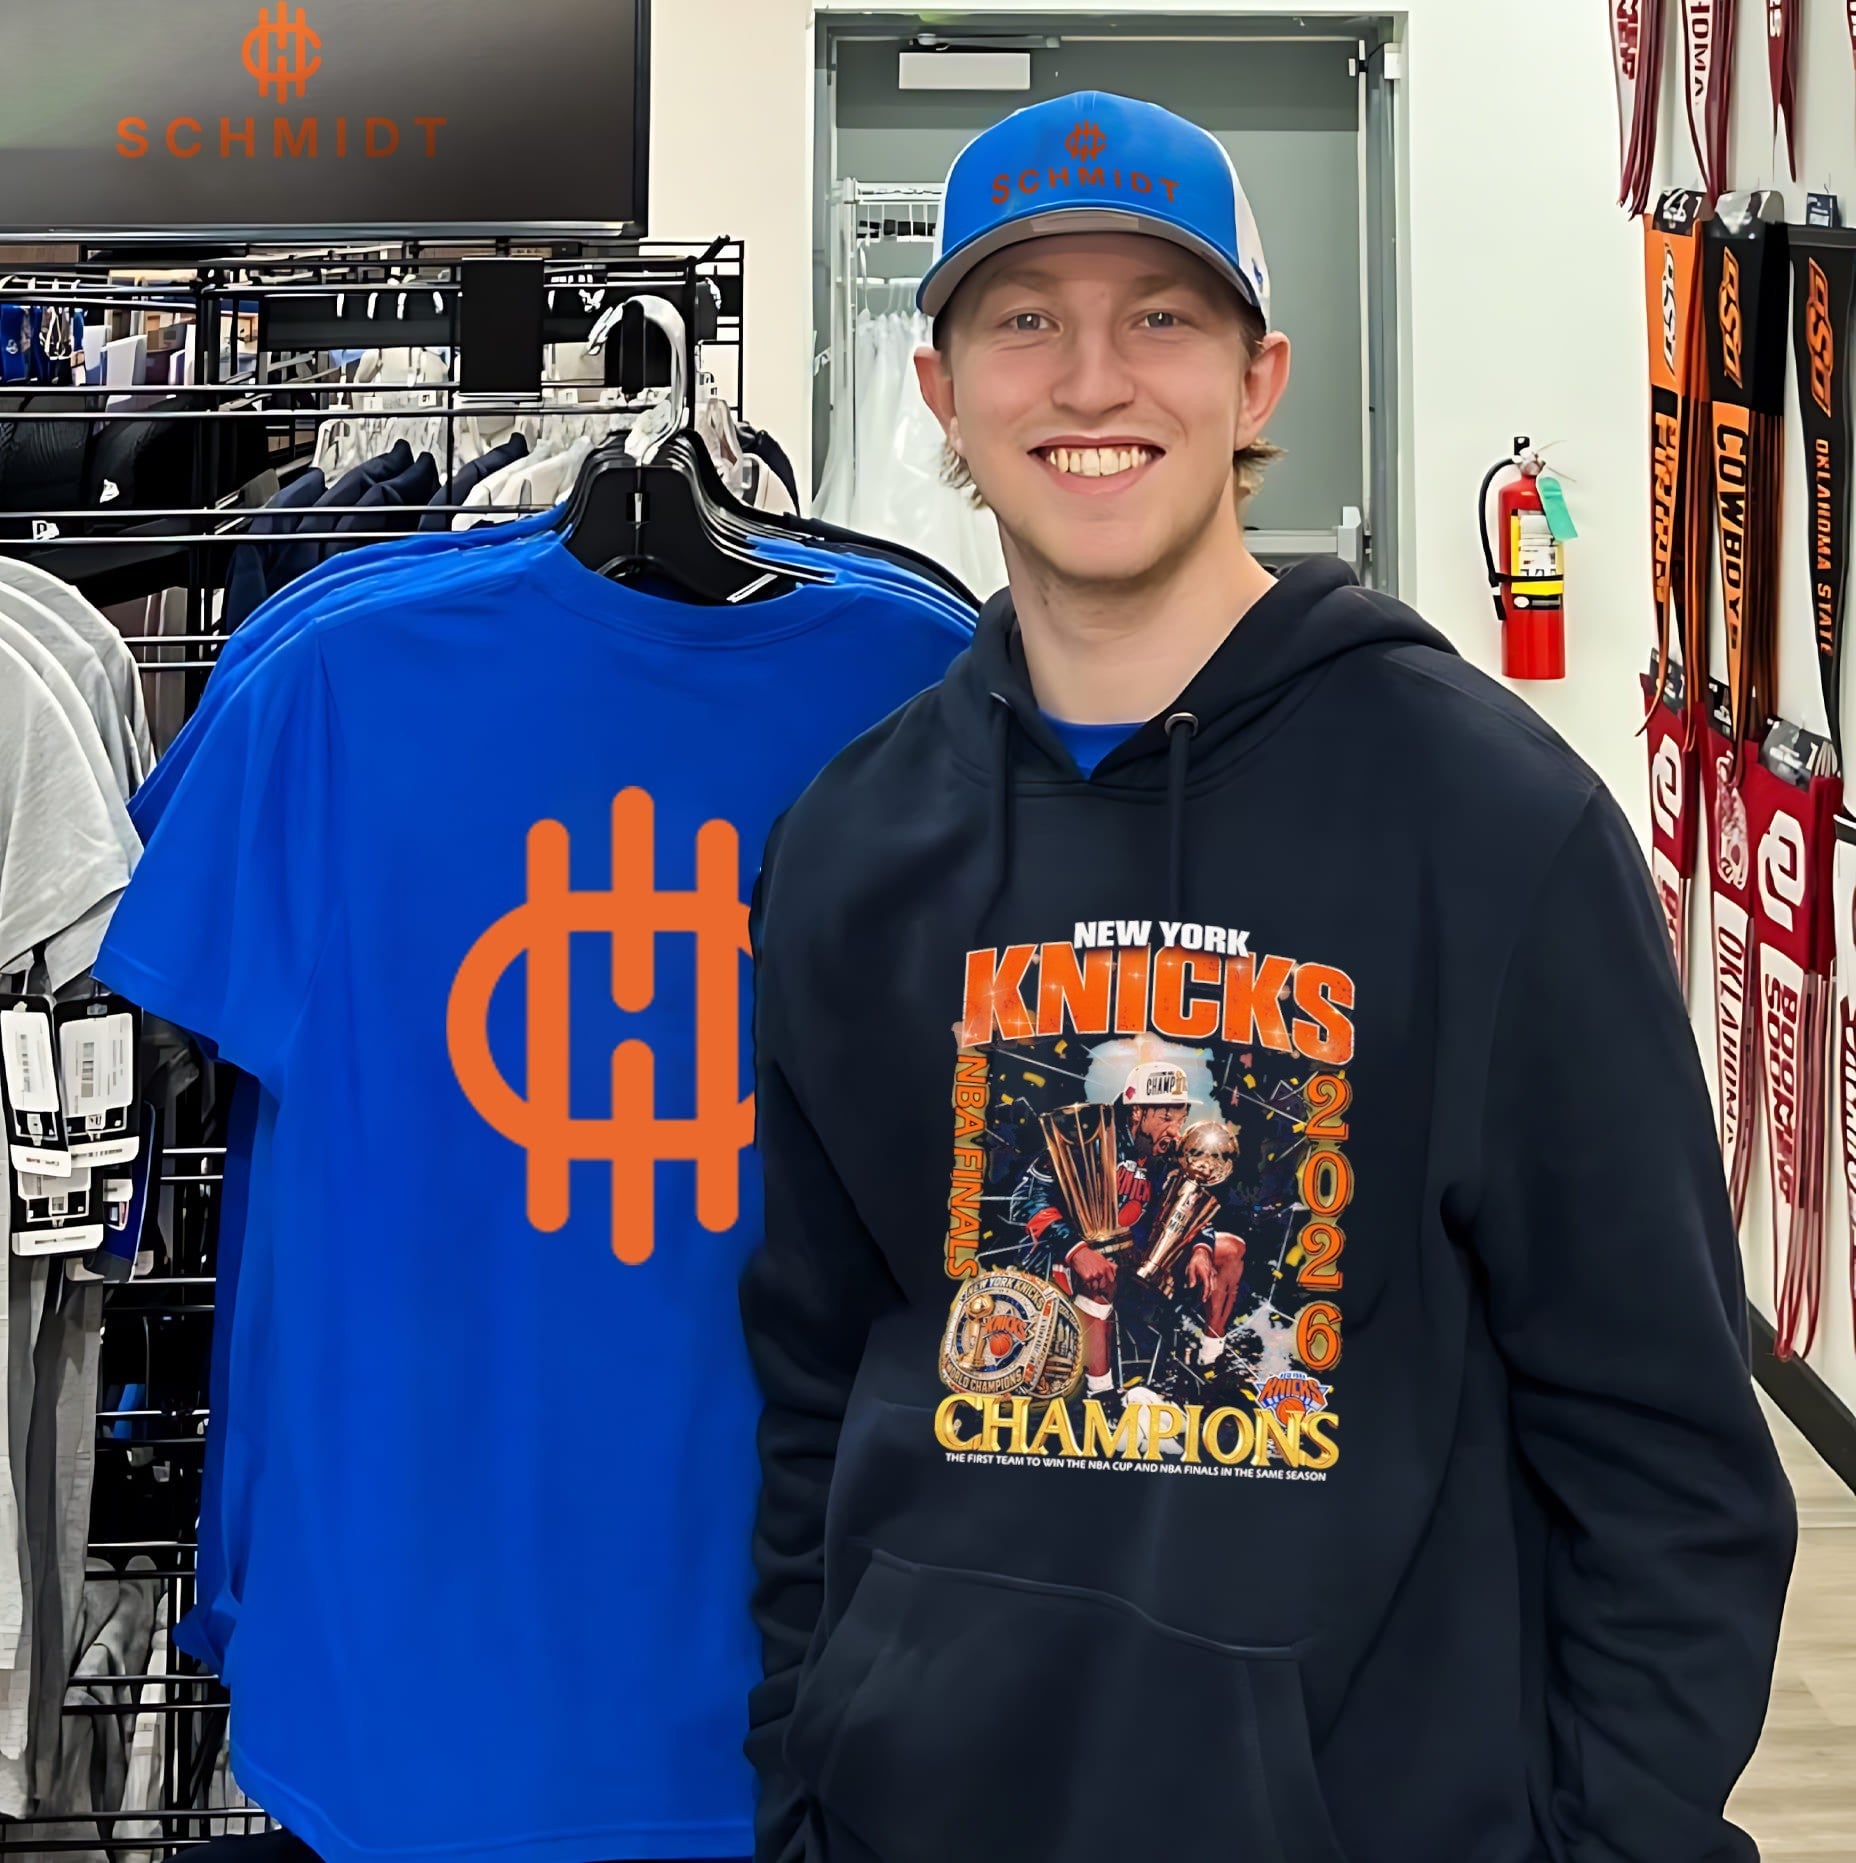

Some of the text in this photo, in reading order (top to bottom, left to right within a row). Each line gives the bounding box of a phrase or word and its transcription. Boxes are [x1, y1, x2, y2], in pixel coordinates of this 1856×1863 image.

[116, 116, 446, 158] SCHMIDT
[992, 167, 1180, 204] SCHMIDT
[1815, 437, 1832, 571] OKLAHOMA
[1074, 919, 1251, 959] NEW YORK
[961, 941, 1358, 1066] KNICKS
[947, 1054, 988, 1279] NBA FINALS
[1296, 1074, 1352, 1373] 2026
[988, 1276, 1013, 1289] YORK
[1015, 1279, 1045, 1312] KNICKS
[983, 1314, 1029, 1341] KNICKS
[944, 1362, 1023, 1394] WORLD CHAMPIONS
[1258, 1375, 1326, 1407] KNICKS
[934, 1392, 1341, 1471] CHAMPIONS
[944, 1452, 1327, 1482] THE FIRST TEAM TO WIN THE NBA CUP AND NBA FINALS IN THE SAME SEASON
